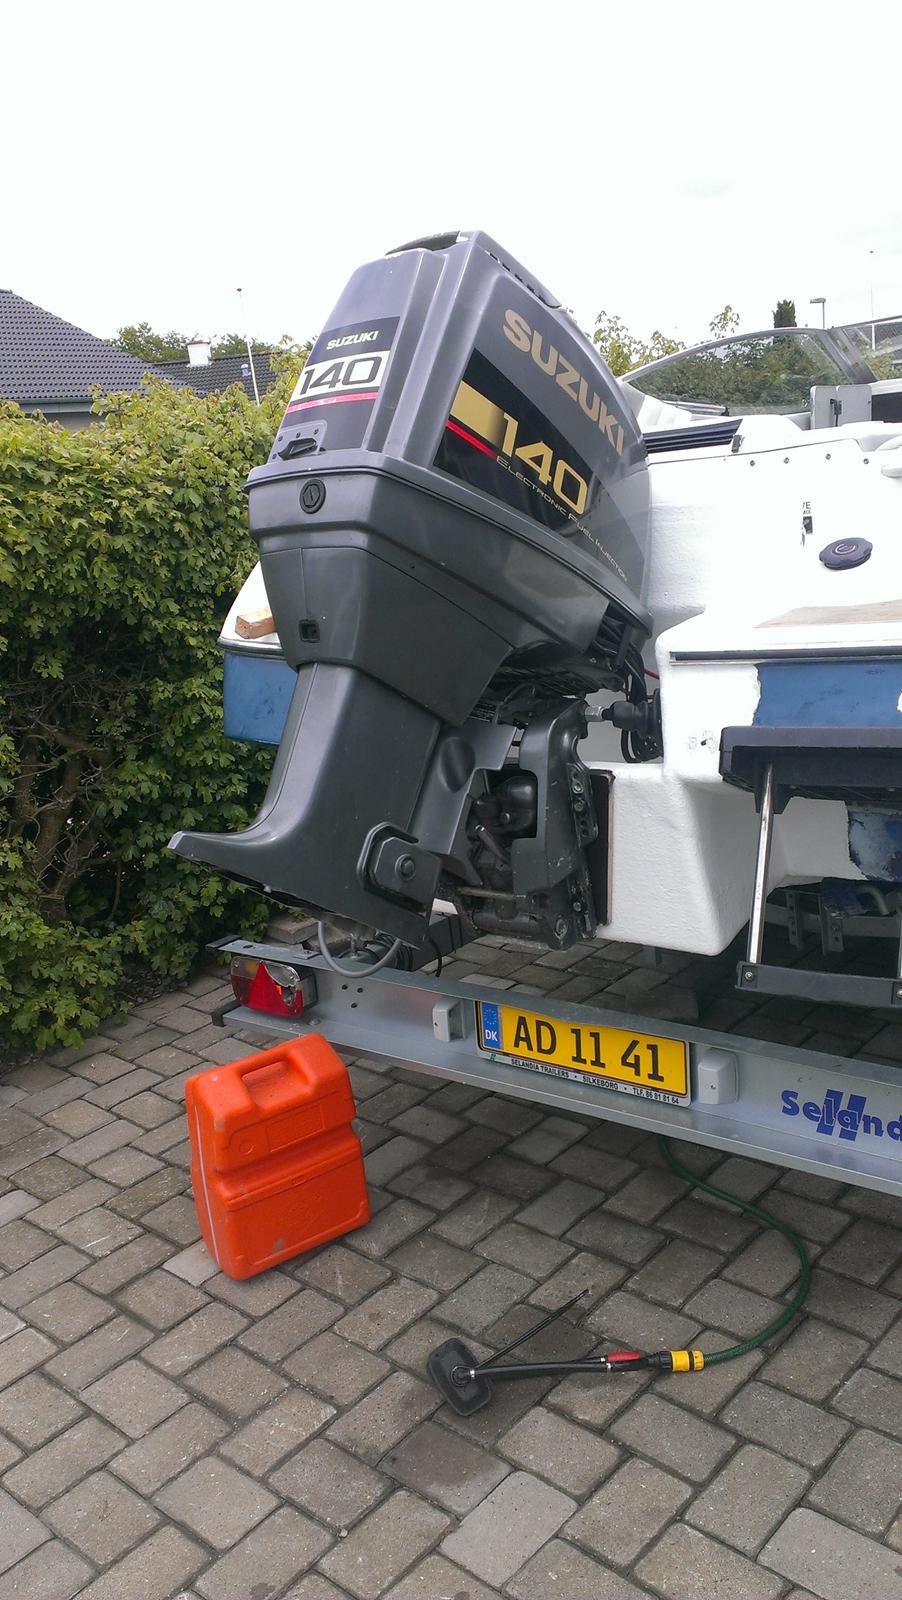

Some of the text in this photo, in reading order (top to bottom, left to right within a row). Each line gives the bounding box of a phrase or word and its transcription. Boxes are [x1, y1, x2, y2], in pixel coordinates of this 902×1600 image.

[326, 331, 379, 350] SUZUKI
[300, 356, 382, 395] 140
[502, 308, 625, 456] SUZUKI
[495, 412, 589, 515] 140
[496, 455, 567, 516] ELECTRONIC
[568, 513, 595, 543] FUEL
[485, 1029, 498, 1041] DK
[513, 1015, 664, 1083] AD 11 41
[511, 1058, 540, 1071] SELANDIA
[540, 1065, 569, 1079] TRAILERS
[582, 1075, 619, 1090] SILKEBORG
